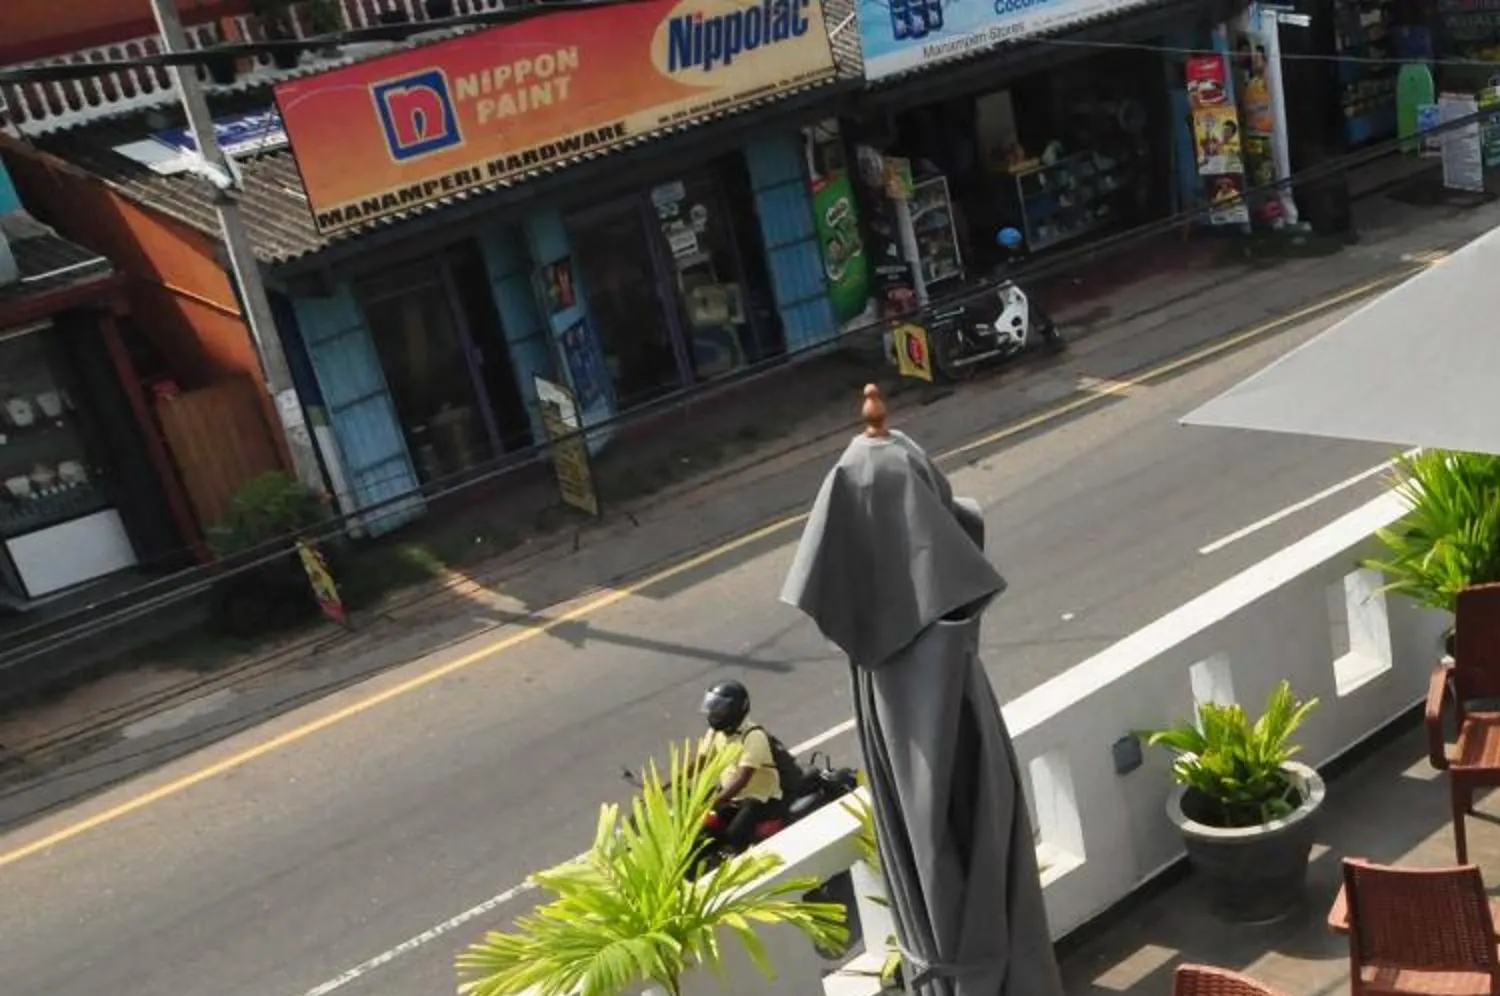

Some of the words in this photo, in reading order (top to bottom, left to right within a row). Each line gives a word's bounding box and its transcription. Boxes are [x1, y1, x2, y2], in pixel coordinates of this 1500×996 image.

[668, 0, 809, 72] Nippolac
[455, 46, 579, 100] NIPPON
[477, 76, 572, 124] PAINT
[318, 166, 482, 228] MANAMPERI
[487, 121, 626, 176] HARDWARE
